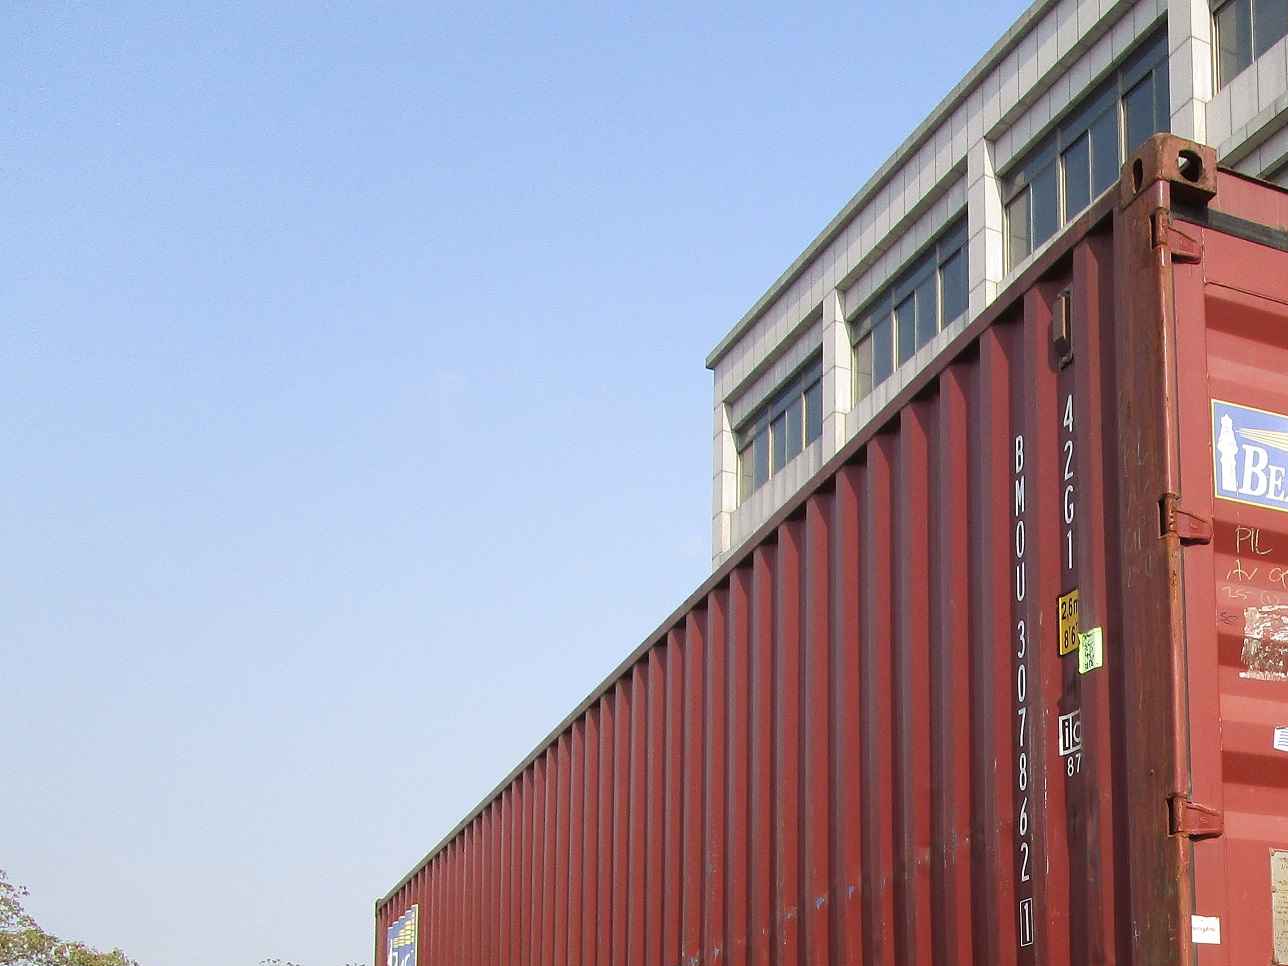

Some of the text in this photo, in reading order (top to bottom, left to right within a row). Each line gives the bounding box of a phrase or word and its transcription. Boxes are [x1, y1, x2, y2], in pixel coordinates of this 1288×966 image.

[1062, 393, 1074, 570] 42G1
[1015, 434, 1031, 944] BMOU 307862 1
